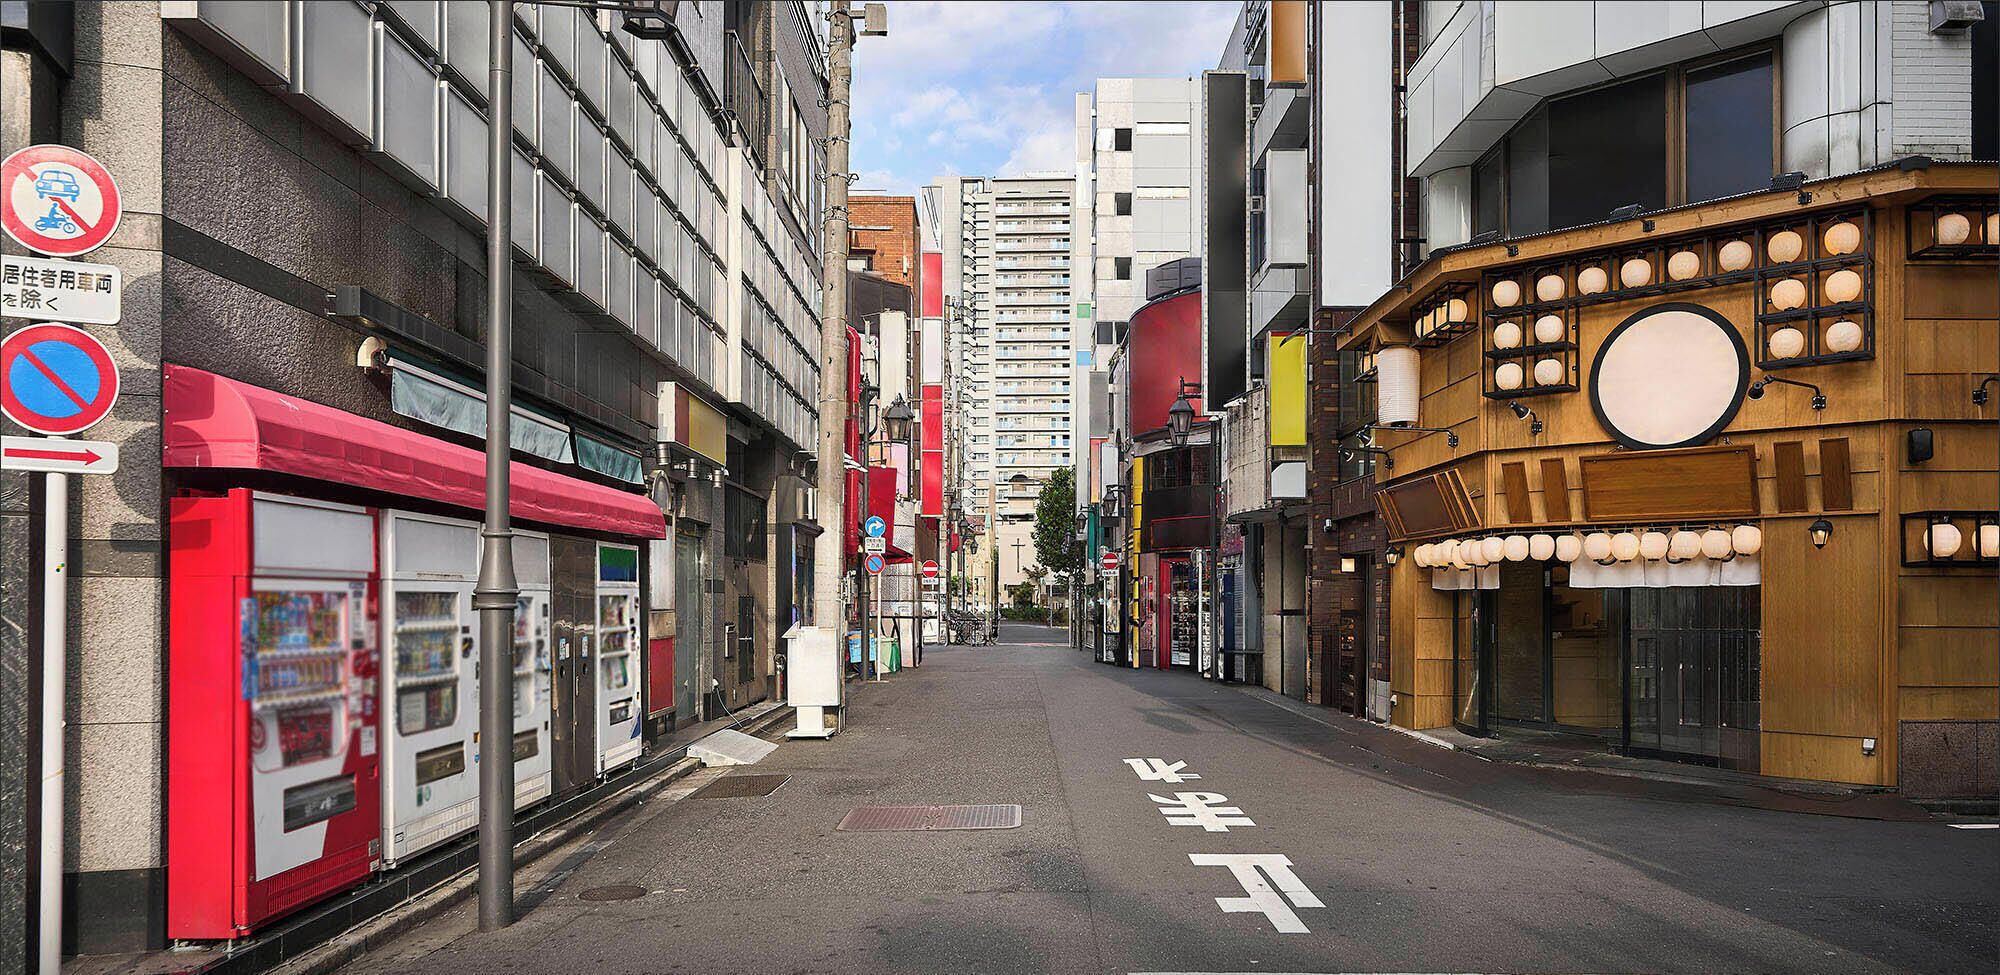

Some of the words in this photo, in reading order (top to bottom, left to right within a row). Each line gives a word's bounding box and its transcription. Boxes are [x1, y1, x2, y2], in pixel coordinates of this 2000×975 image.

[3, 264, 112, 294] 居住者用車両
[3, 288, 58, 311] を除く
[1122, 758, 1326, 934] 止まれ
